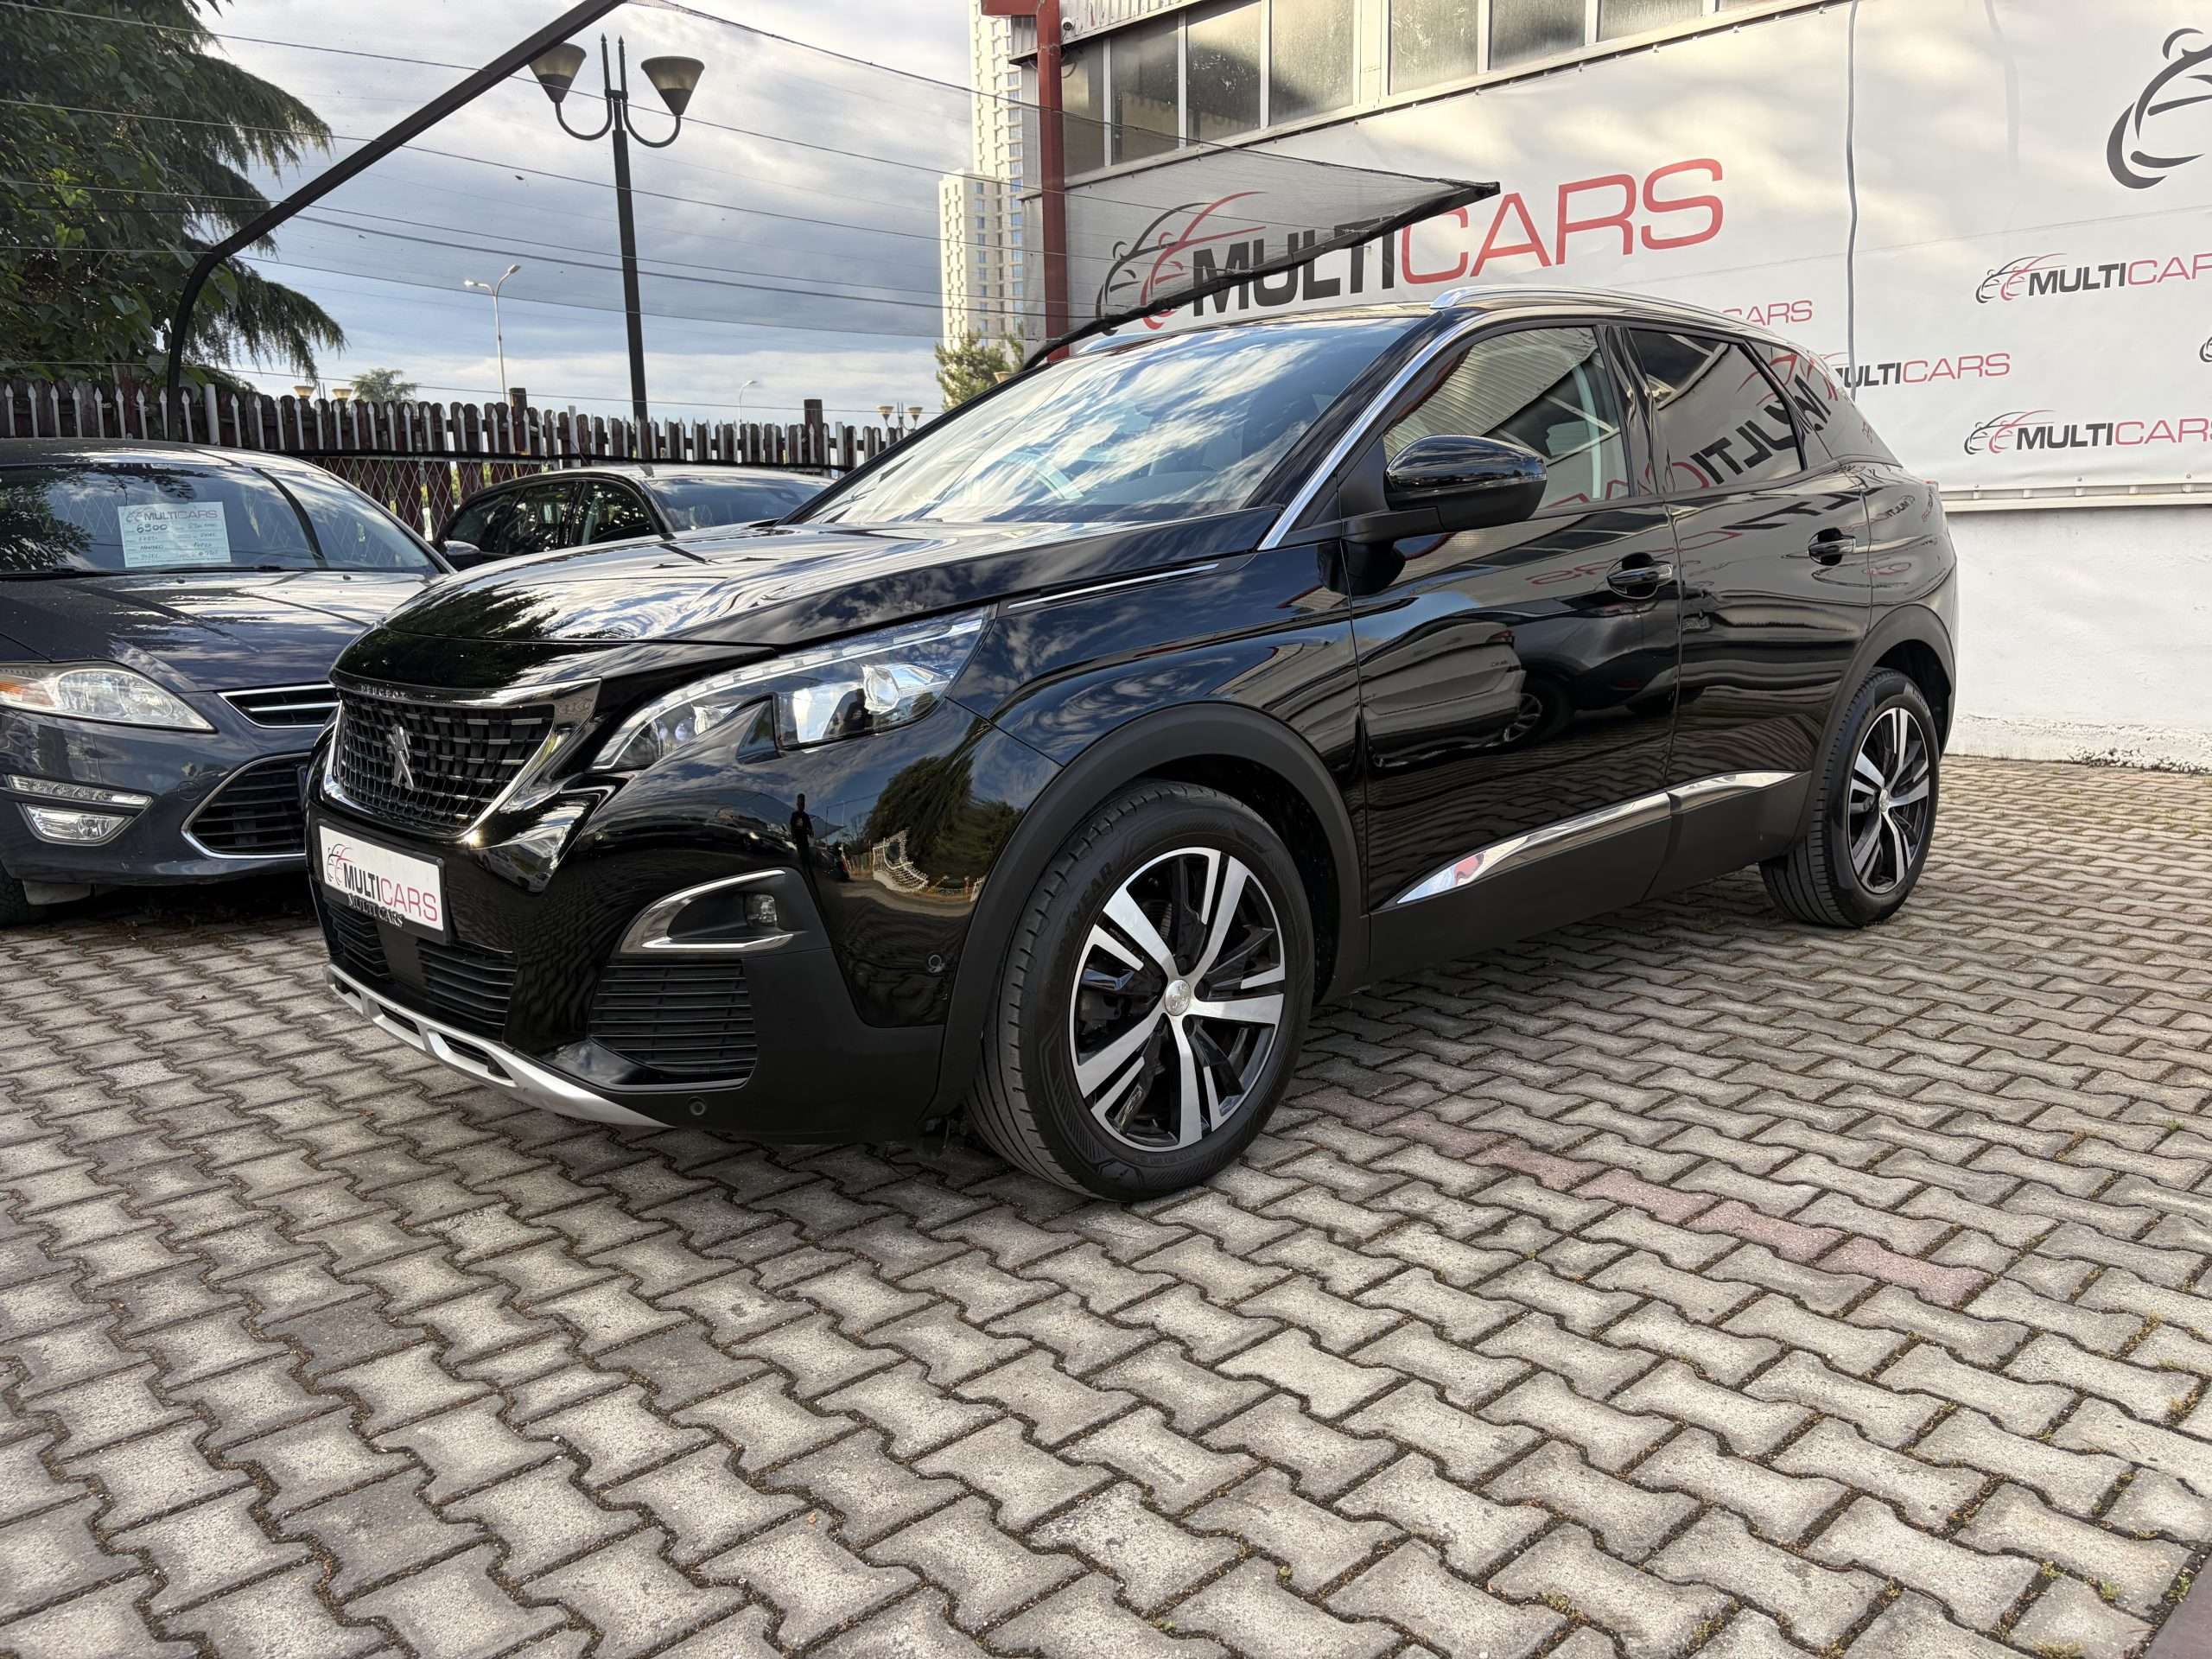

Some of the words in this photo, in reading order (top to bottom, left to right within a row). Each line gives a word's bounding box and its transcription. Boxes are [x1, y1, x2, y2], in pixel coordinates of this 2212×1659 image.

[1192, 158, 1724, 317] MULTICARS
[1835, 353, 2011, 388] ULTICARS
[143, 510, 218, 521] MULTICARS
[343, 862, 438, 923] MULTICARS
